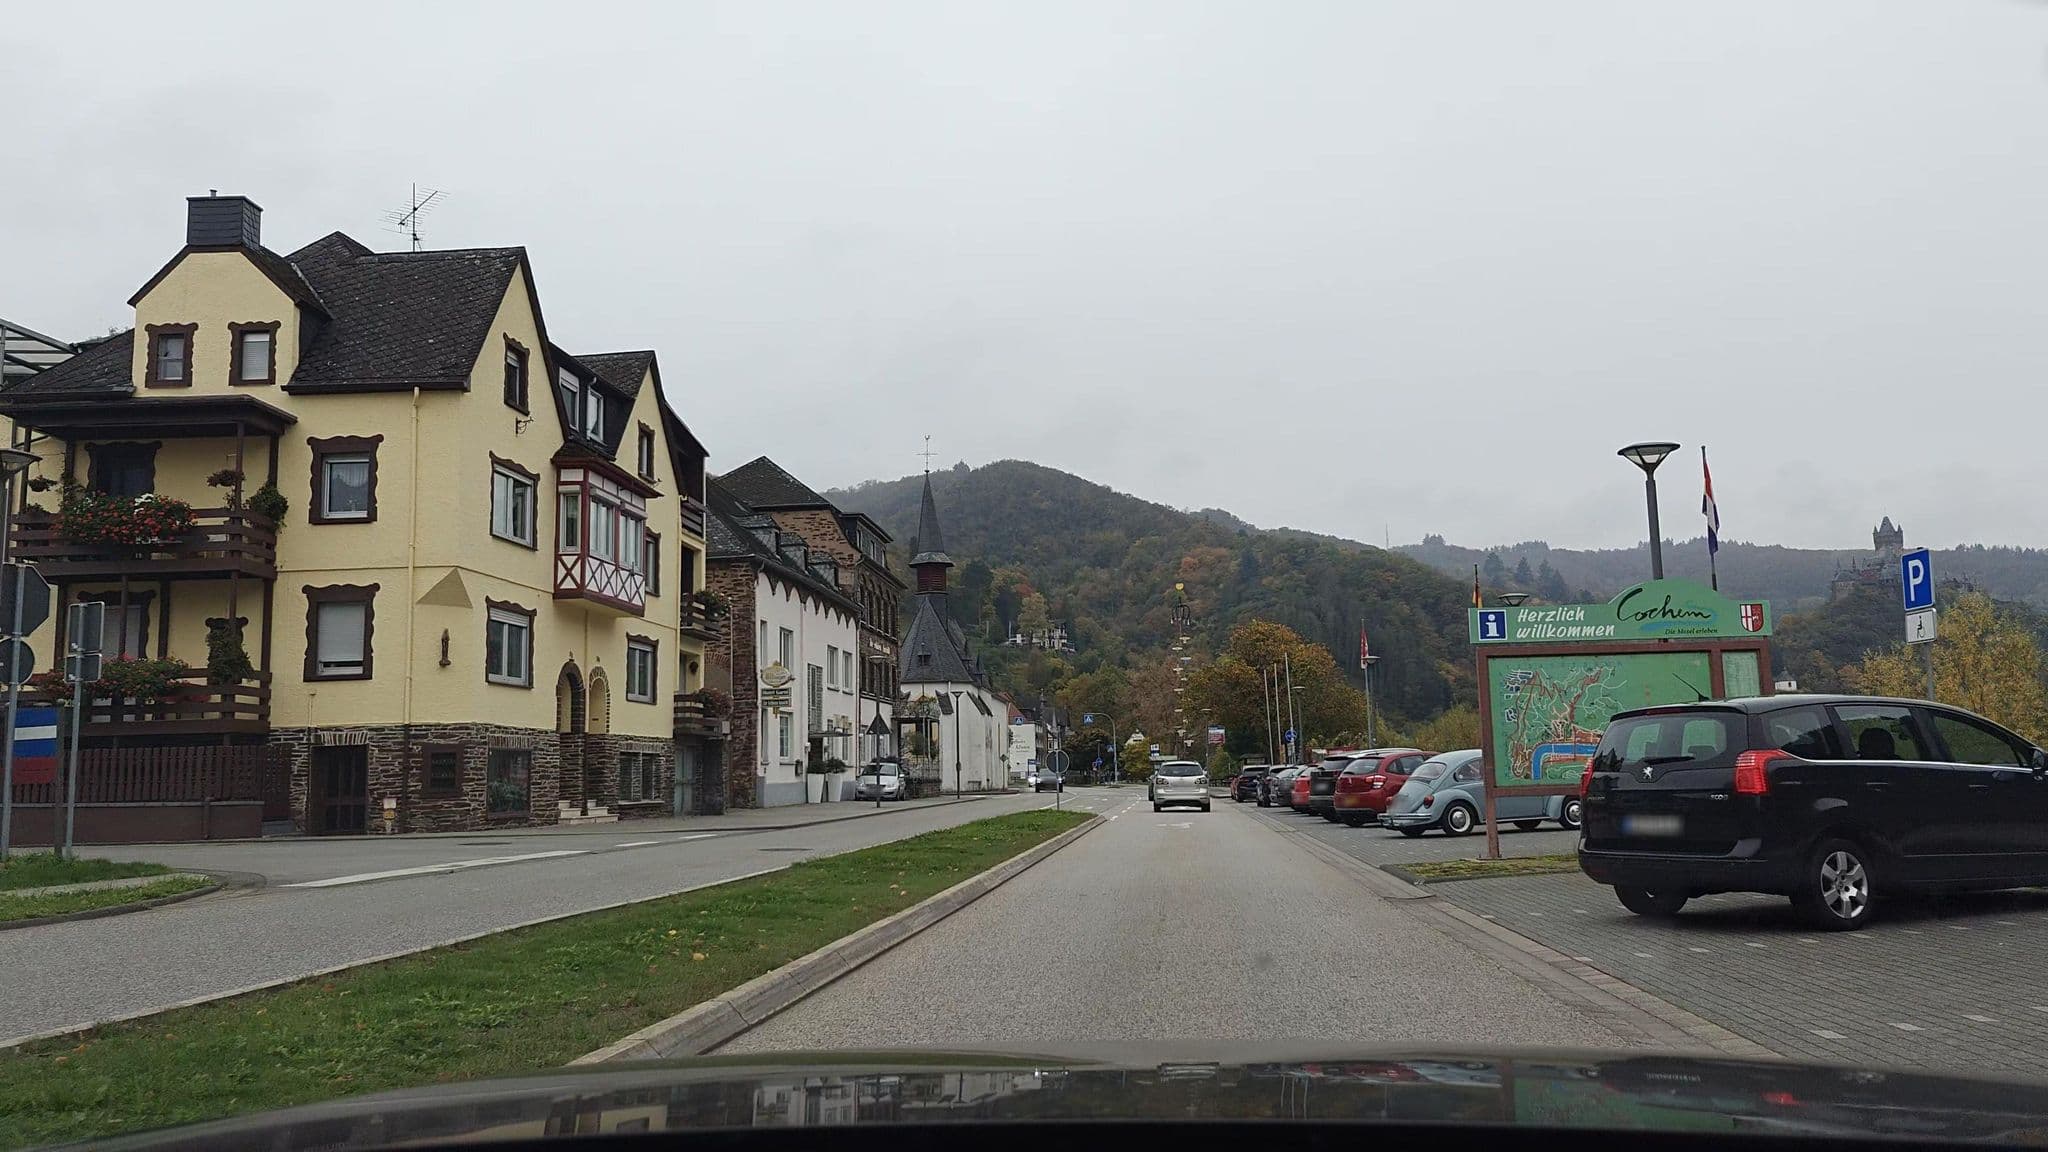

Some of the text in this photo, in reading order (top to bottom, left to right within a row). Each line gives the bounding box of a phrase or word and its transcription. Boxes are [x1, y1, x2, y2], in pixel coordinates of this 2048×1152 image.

[1908, 559, 1925, 602] P
[1517, 607, 1585, 622] Herzlich
[1617, 587, 1712, 621] Cochem
[1516, 624, 1616, 638] willkommen
